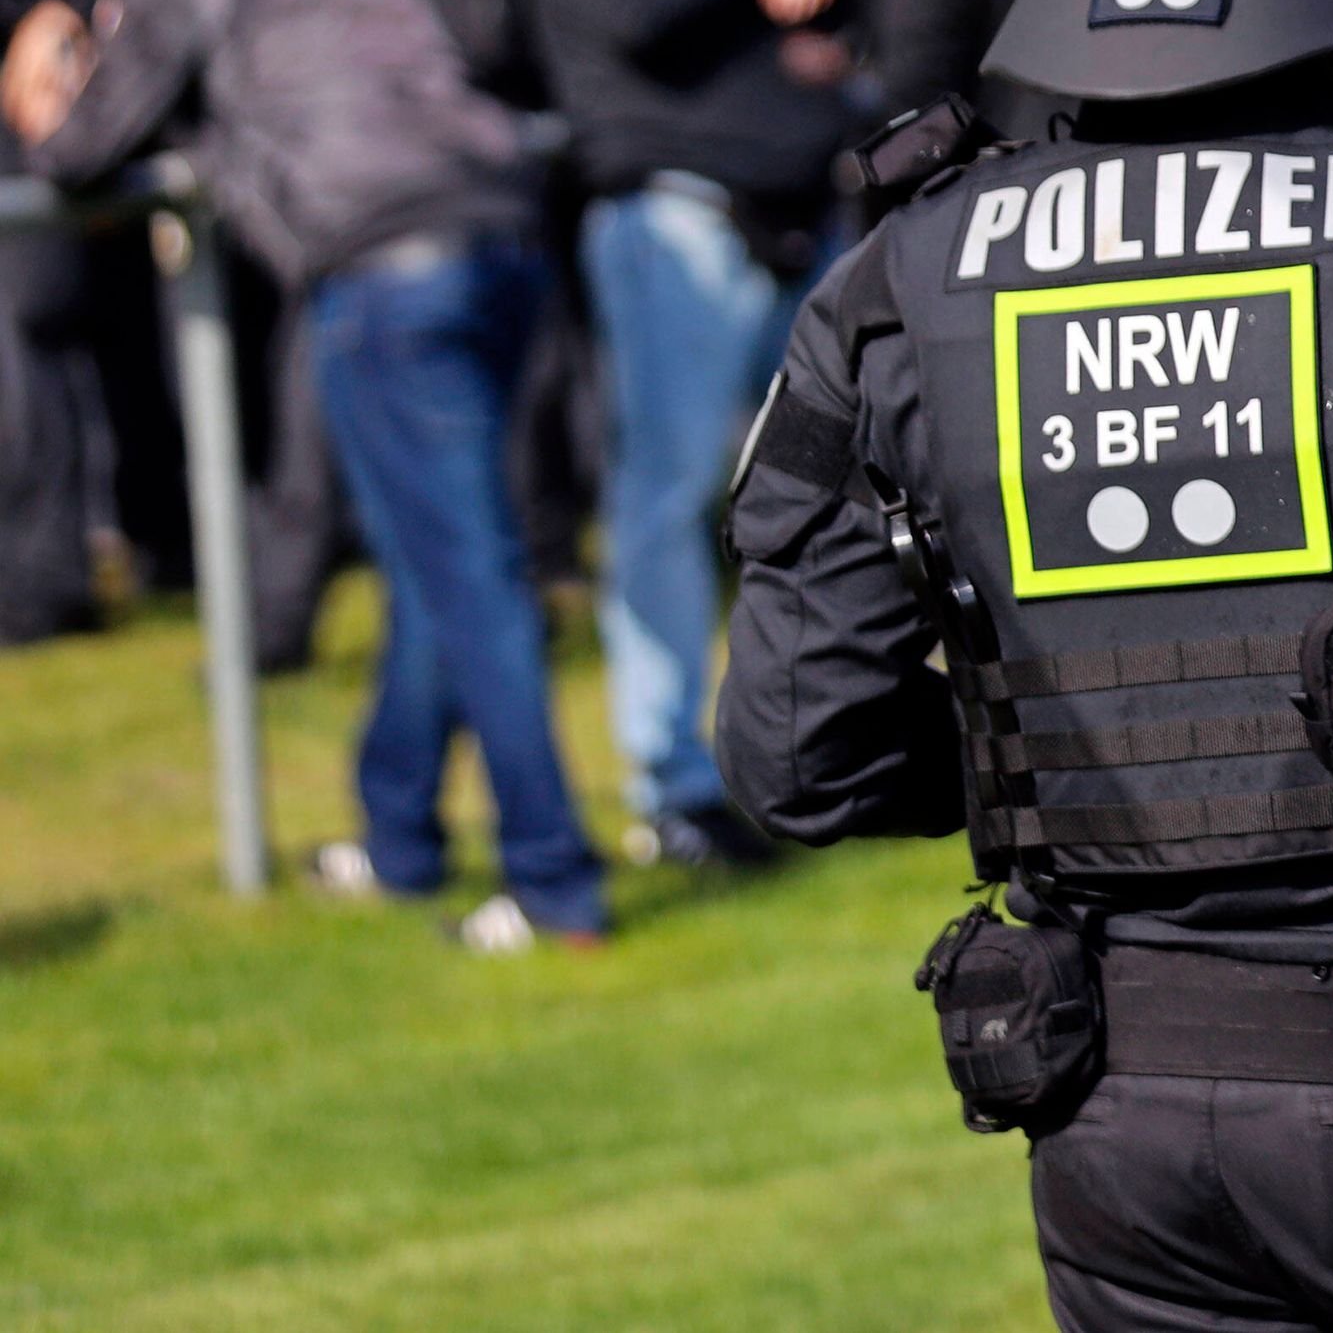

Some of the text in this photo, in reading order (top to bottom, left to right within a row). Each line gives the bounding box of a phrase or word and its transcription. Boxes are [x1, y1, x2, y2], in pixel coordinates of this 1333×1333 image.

[1066, 307, 1240, 394] NRW
[1042, 398, 1263, 472] 3 BF 11
